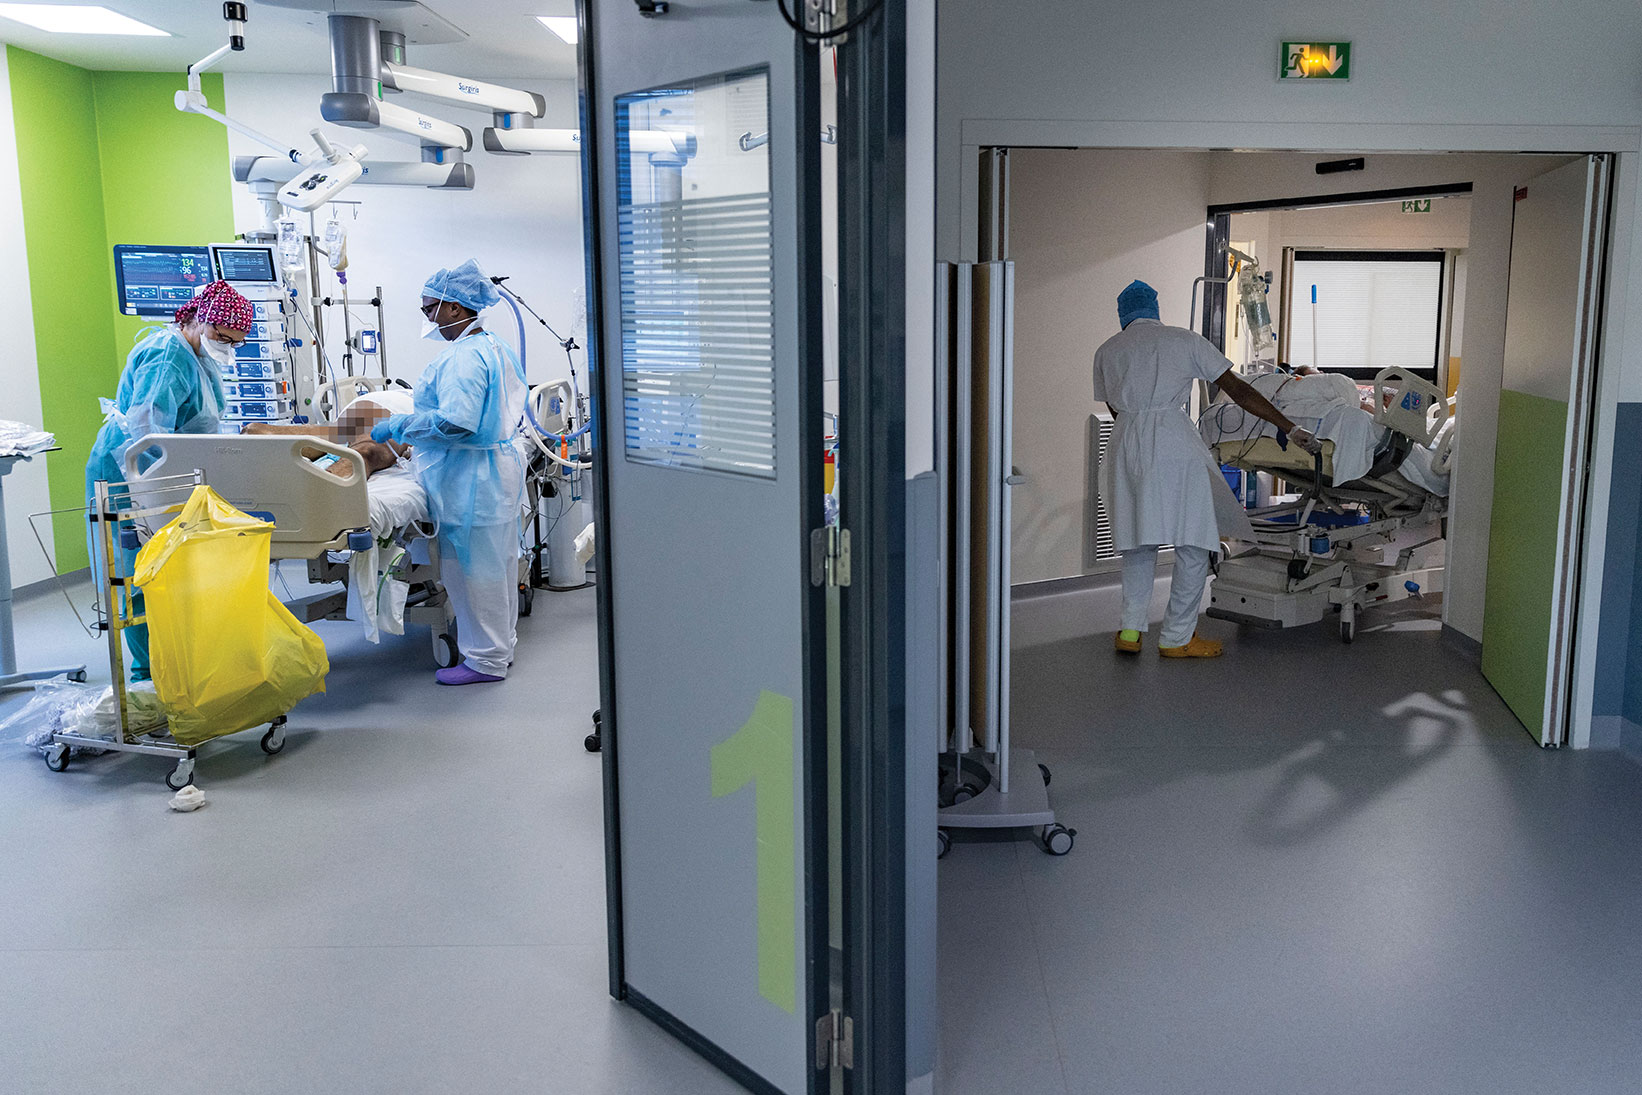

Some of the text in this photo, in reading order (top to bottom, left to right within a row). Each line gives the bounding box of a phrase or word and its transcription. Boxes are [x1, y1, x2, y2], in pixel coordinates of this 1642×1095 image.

[181, 258, 194, 267] 134
[182, 266, 192, 275] 96
[710, 688, 795, 1016] 1
